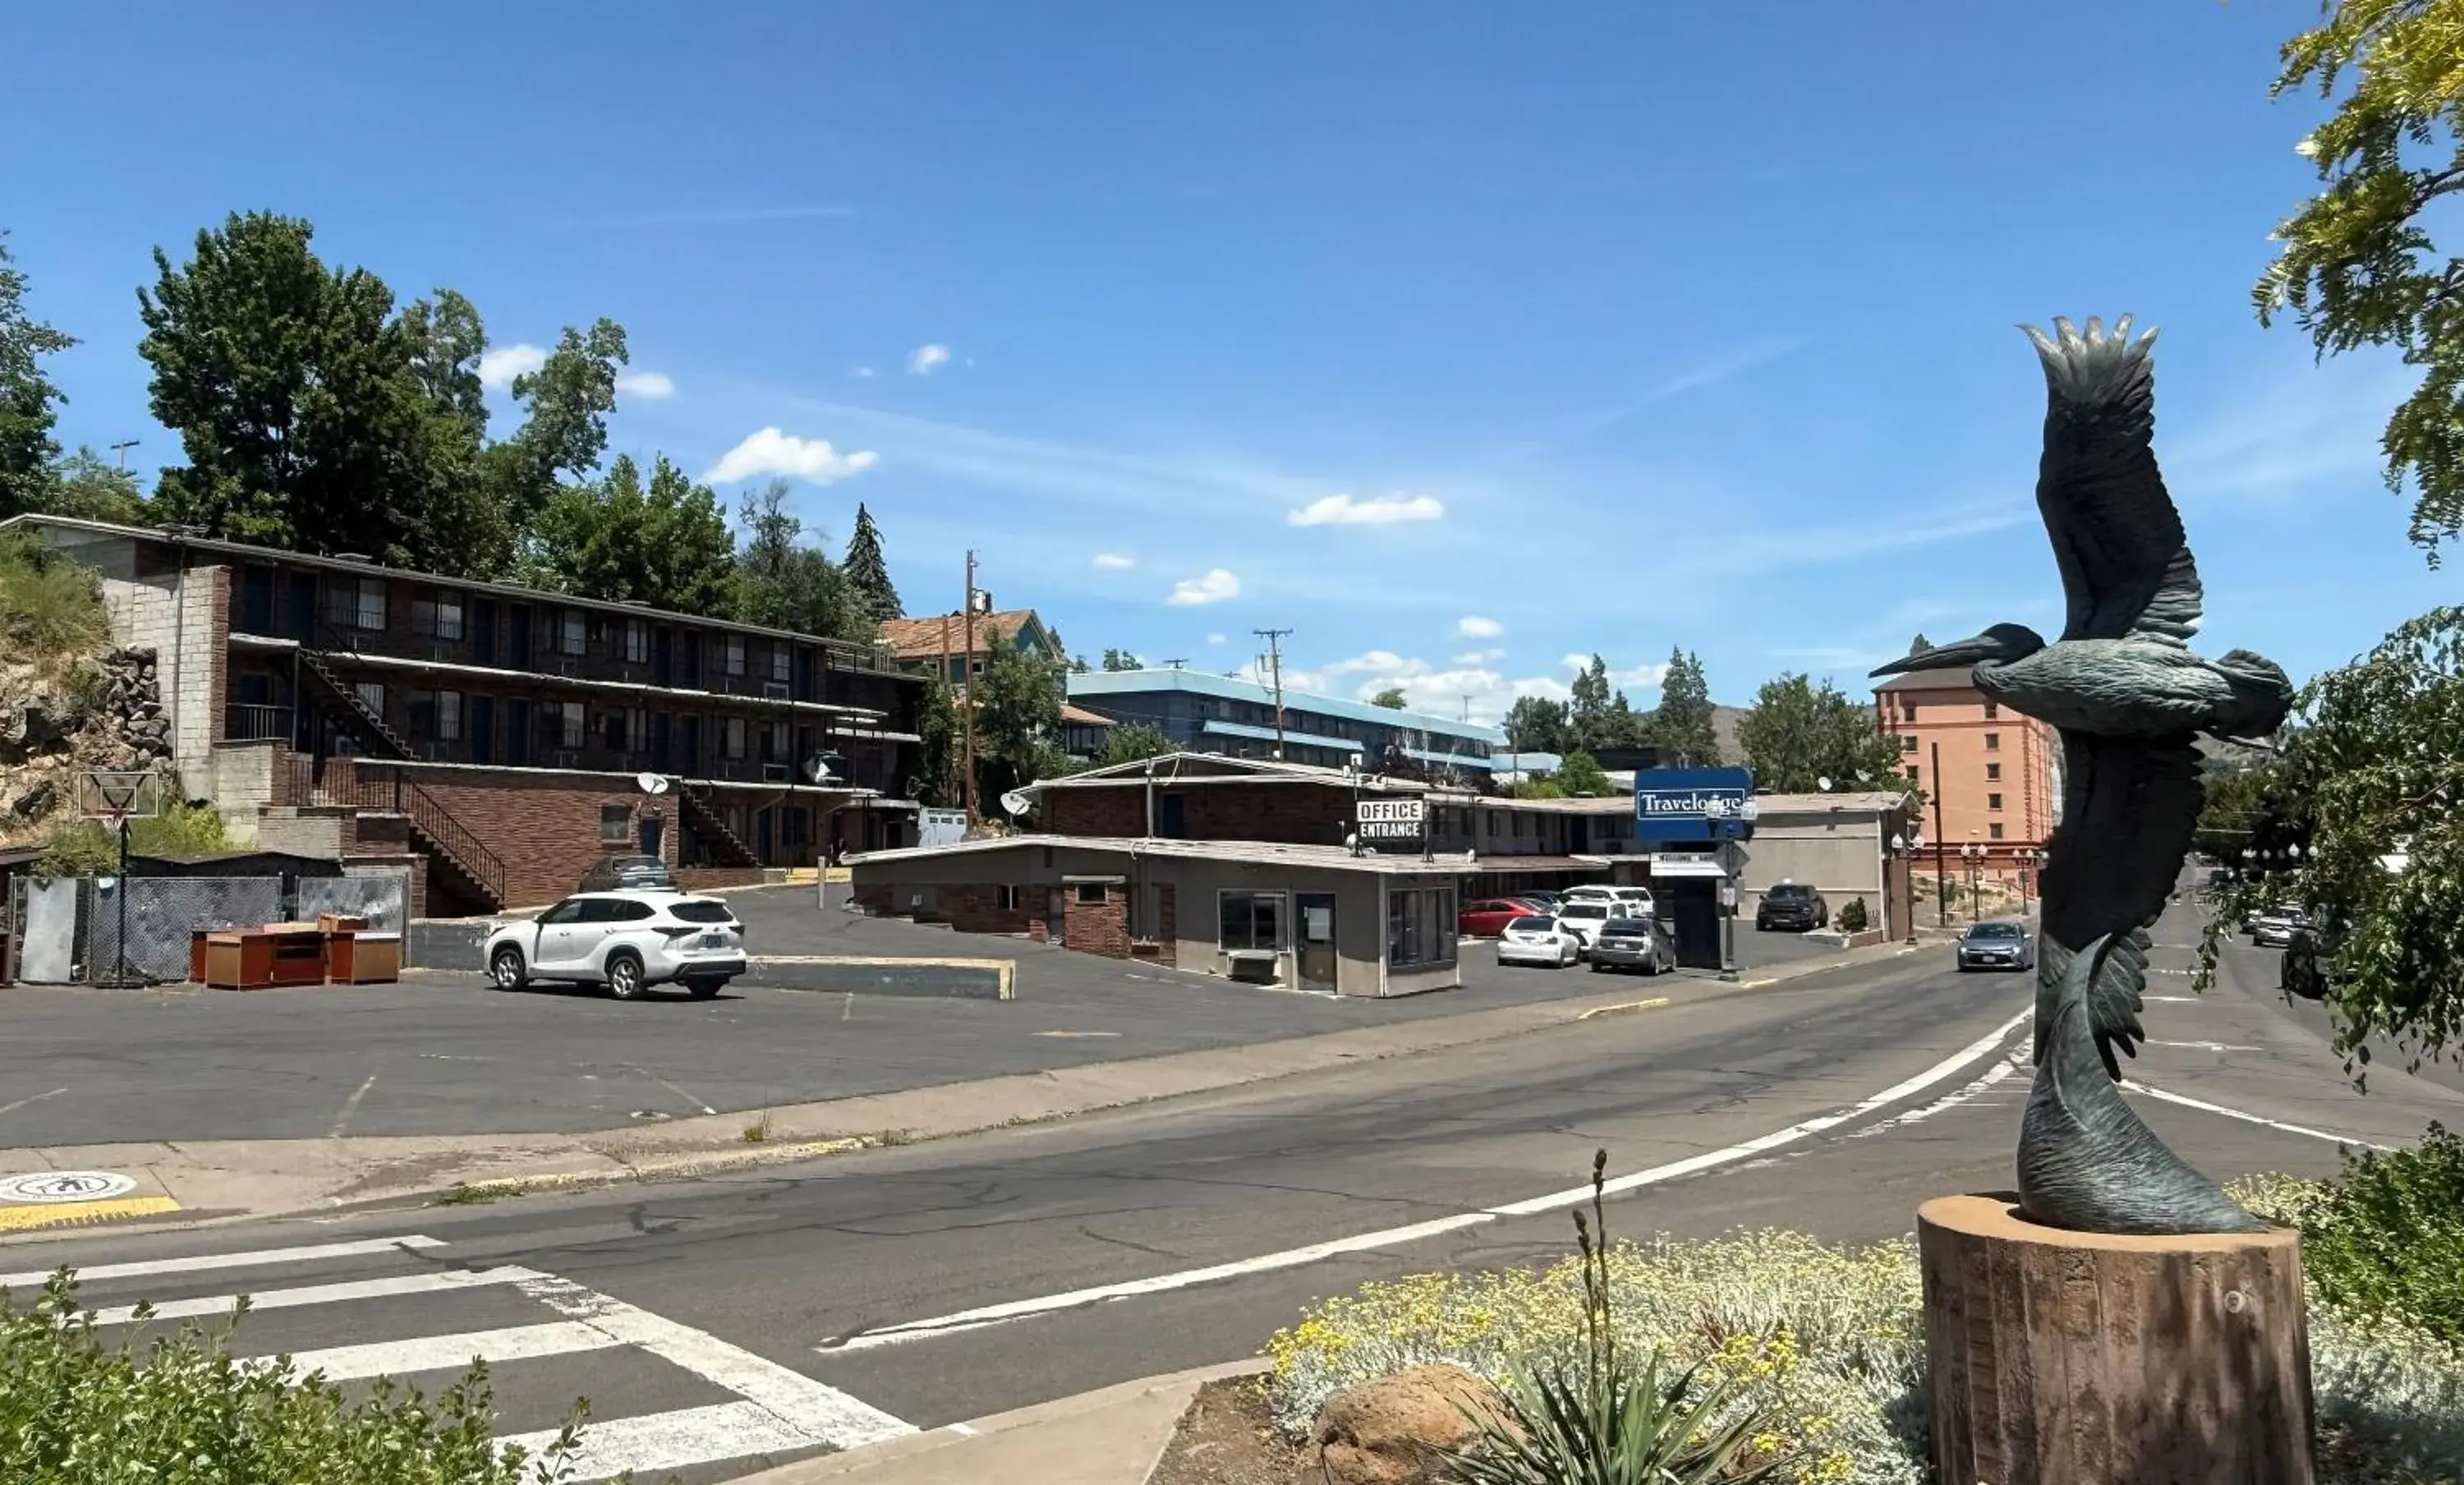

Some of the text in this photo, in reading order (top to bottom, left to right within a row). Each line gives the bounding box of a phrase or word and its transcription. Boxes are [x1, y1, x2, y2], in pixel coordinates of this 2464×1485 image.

[1361, 803, 1418, 819] OFFICE
[1642, 793, 1741, 815] Traveloge
[1360, 822, 1420, 837] ENTRANCE
